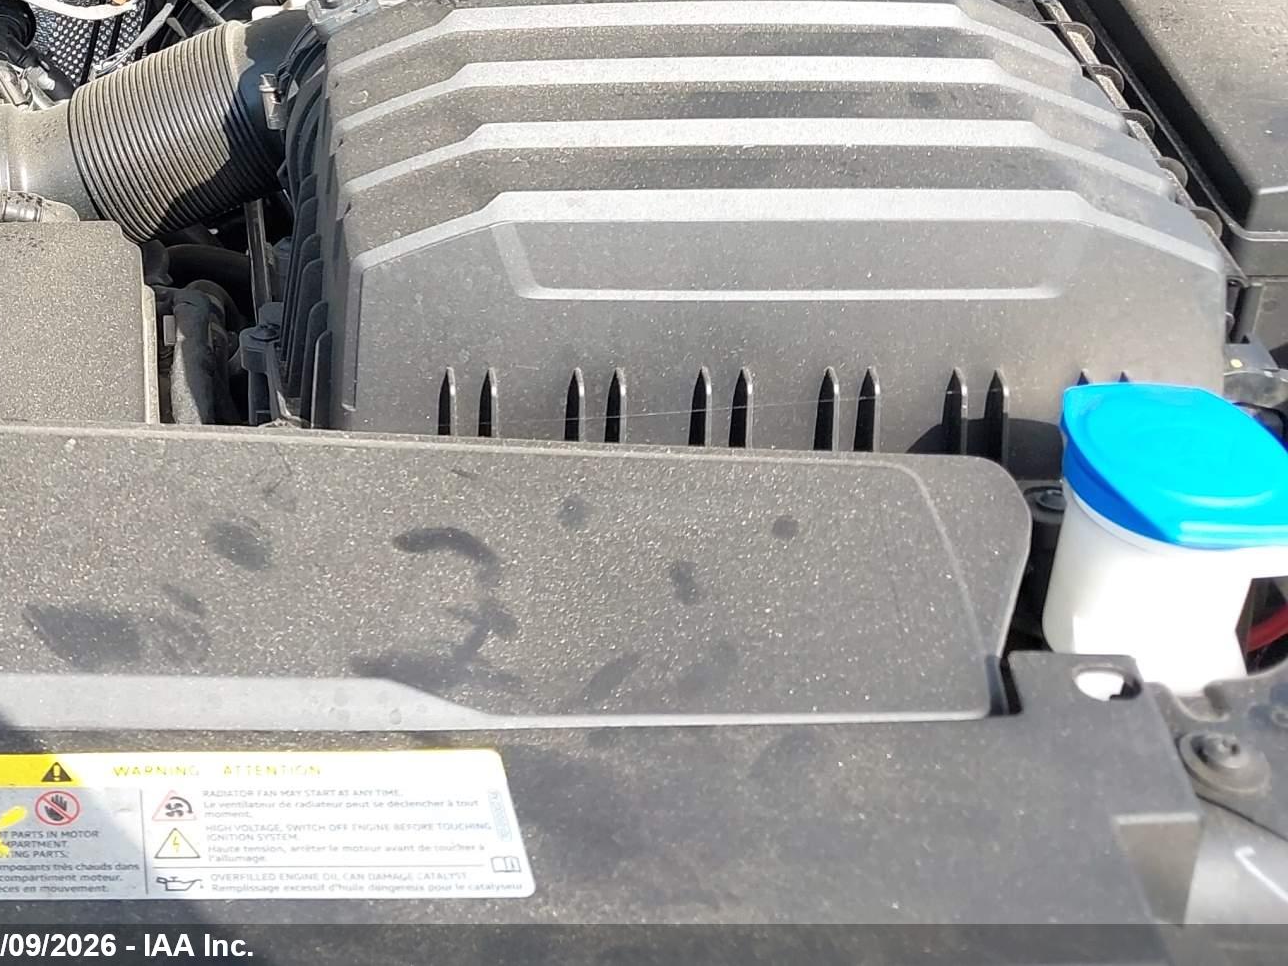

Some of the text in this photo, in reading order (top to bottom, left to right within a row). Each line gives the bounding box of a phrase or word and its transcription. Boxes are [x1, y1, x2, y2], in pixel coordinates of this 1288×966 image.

[111, 764, 322, 777] WARNING ATTENTION
[279, 790, 302, 798] MAY
[304, 789, 337, 797] START
[278, 800, 292, 809] de
[455, 799, 480, 808] tout
[205, 824, 232, 833] HIGH
[285, 823, 326, 832] SWITCH
[10, 830, 44, 840] PARTS
[46, 830, 59, 840] IN
[60, 830, 100, 840] MOTOR
[207, 833, 255, 842] IGNITION
[208, 845, 241, 853] Haute
[53, 862, 74, 872] très
[75, 862, 114, 872] chauds
[115, 863, 141, 872] dans
[79, 873, 125, 883] moteur.
[209, 873, 277, 882] OVERFILLED
[279, 872, 320, 882] ENGINE
[322, 872, 341, 881] OIL
[23, 885, 37, 894] en
[211, 883, 281, 894] Remplissage
[283, 882, 326, 892] excessif
